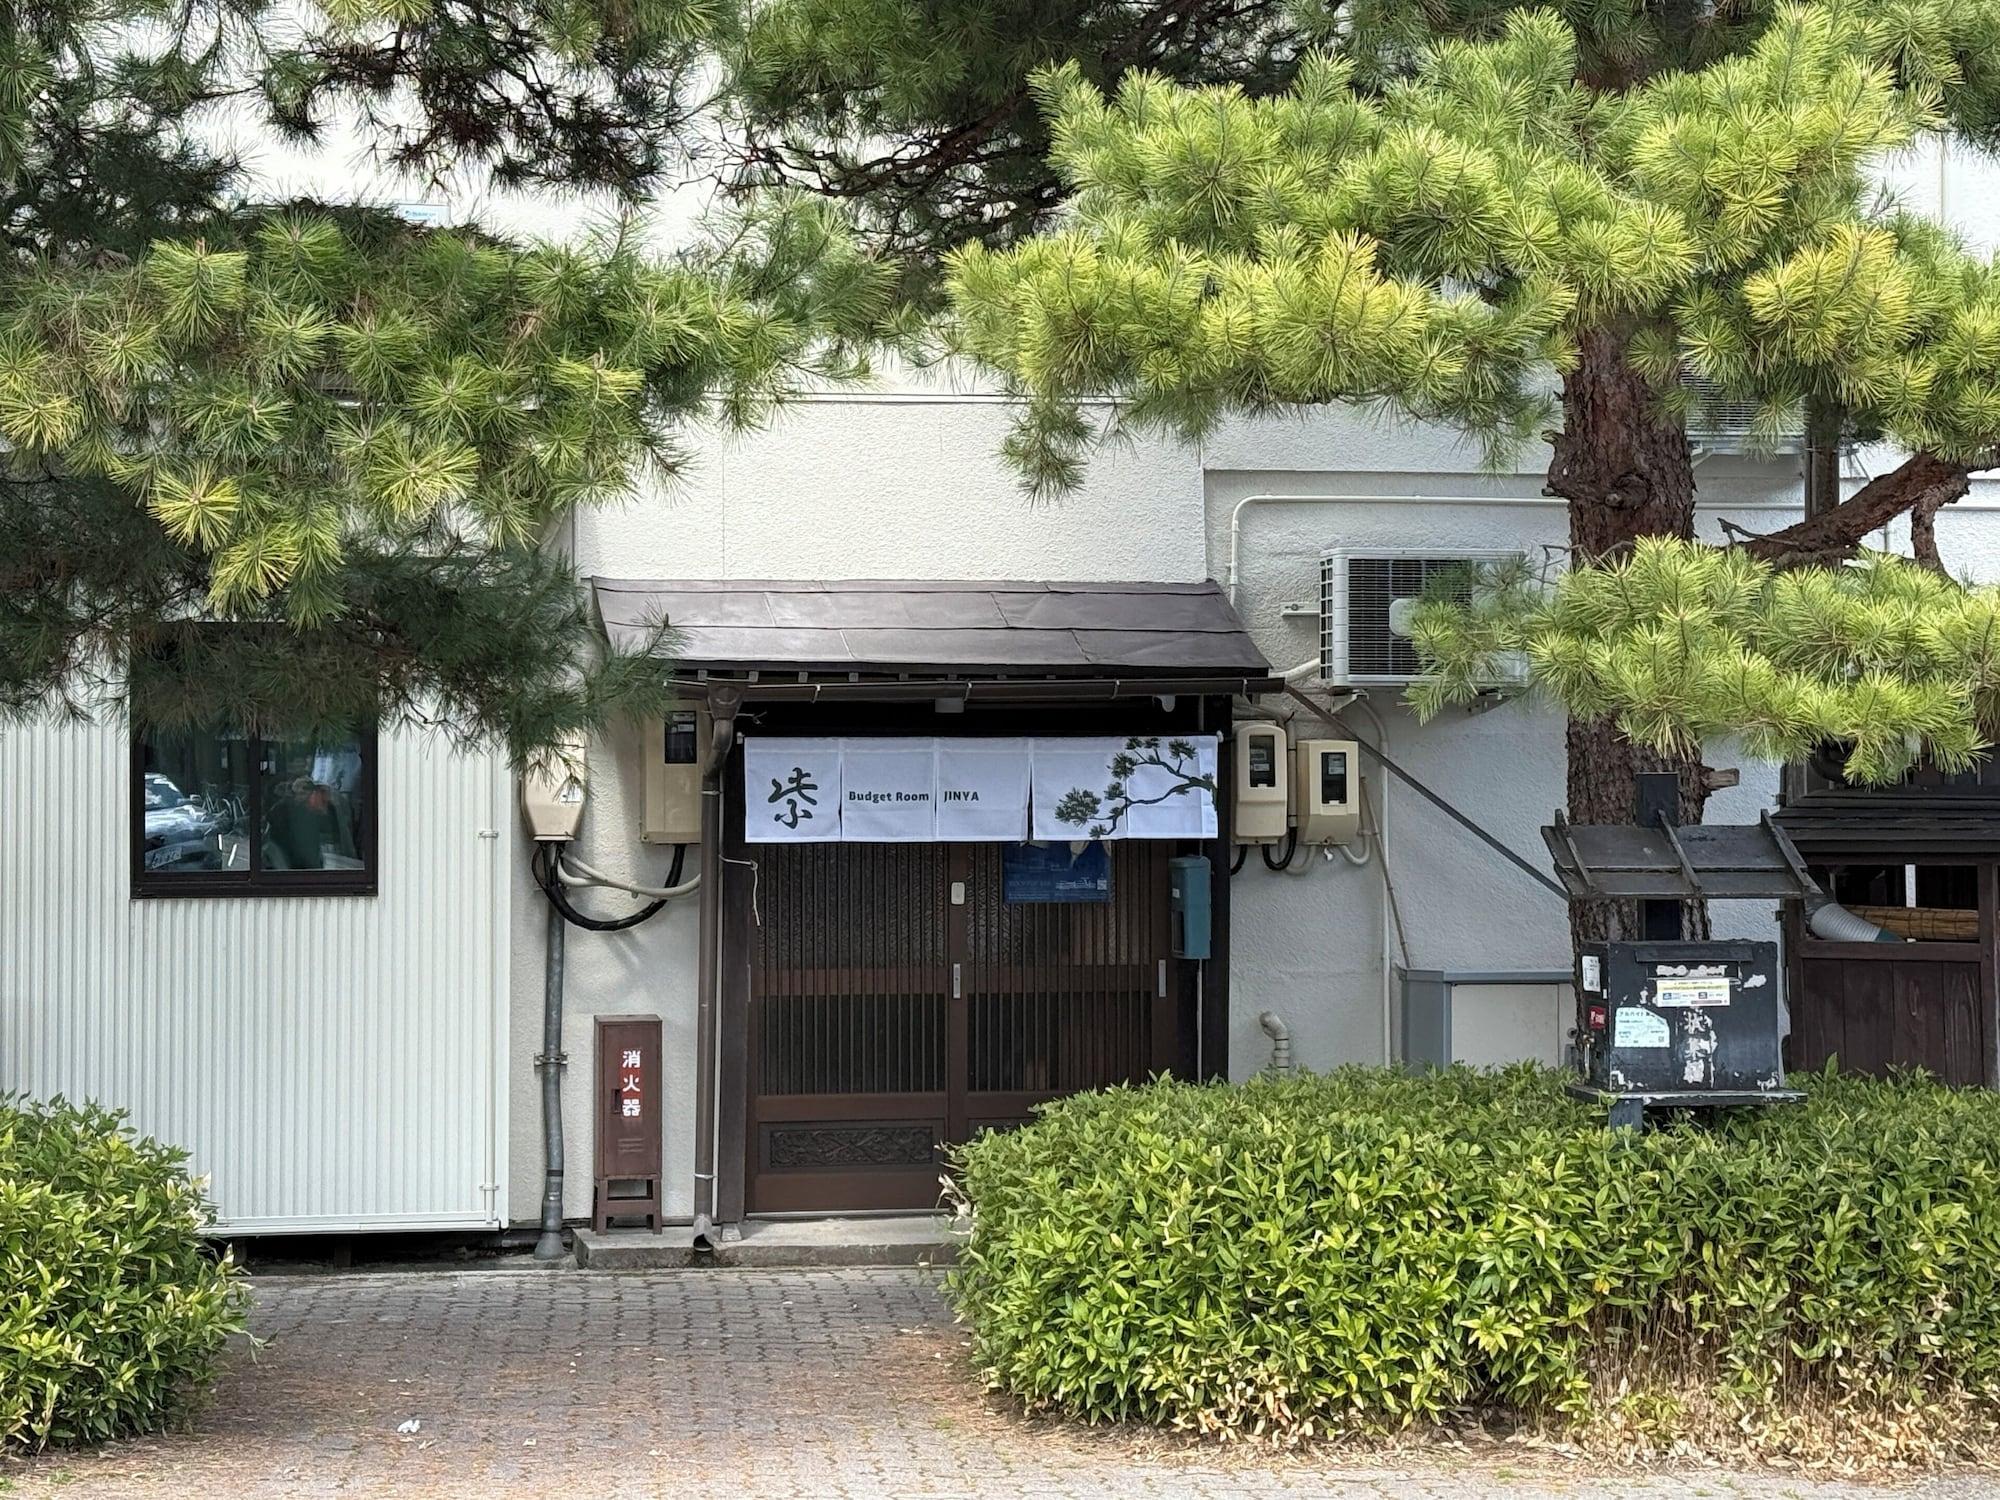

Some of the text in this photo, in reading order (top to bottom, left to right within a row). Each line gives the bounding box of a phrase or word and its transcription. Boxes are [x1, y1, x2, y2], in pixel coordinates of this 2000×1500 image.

[848, 790, 980, 804] Budget Room JINYA
[621, 1049, 642, 1118] 消火器
